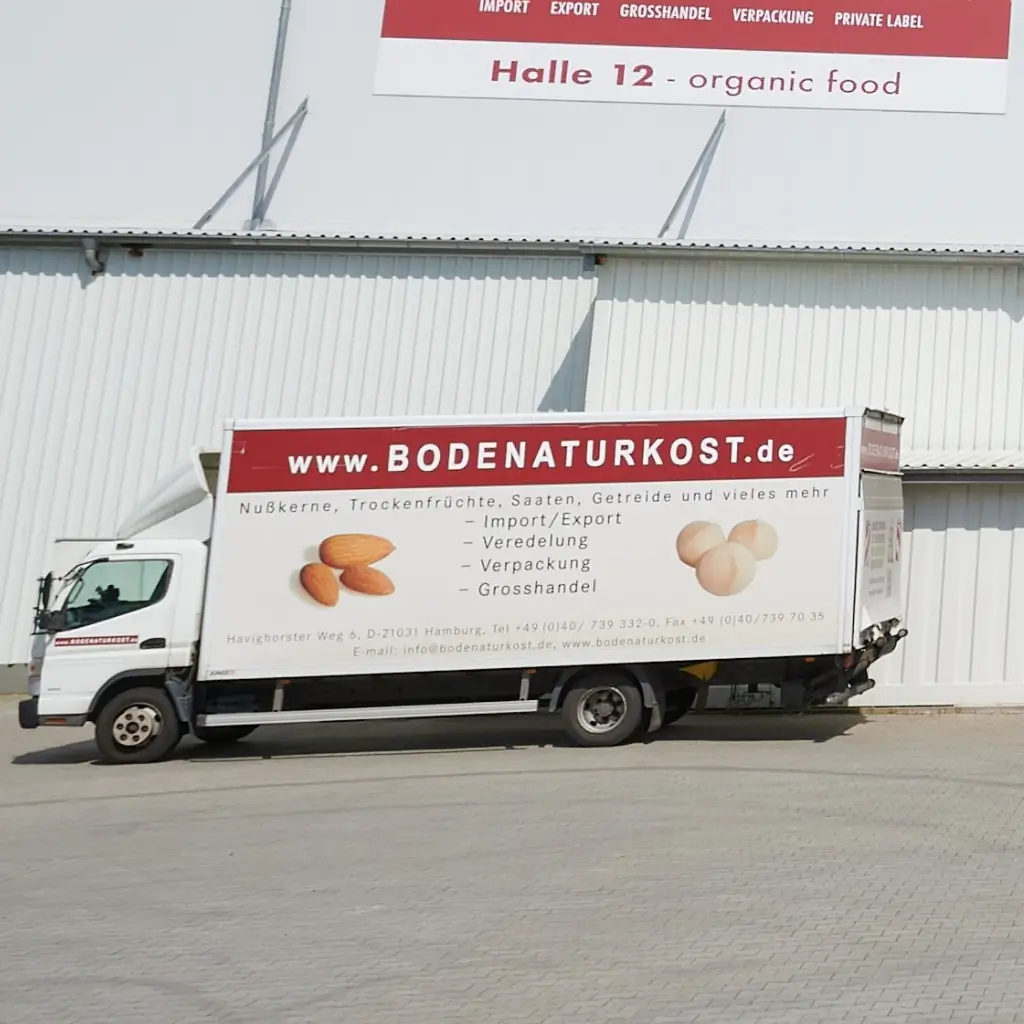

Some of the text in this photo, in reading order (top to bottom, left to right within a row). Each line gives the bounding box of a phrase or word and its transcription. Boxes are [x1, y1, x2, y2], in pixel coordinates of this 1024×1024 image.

[479, 0, 923, 28] IMPORT EXPORT GROSSHANDEL VERPACKUNG PRIVATE LABEL
[492, 60, 592, 84] Halle
[614, 64, 653, 86] 12
[689, 71, 813, 96] organic
[828, 69, 900, 94] food
[289, 437, 793, 473] www.BODENATURKOST.de
[240, 487, 828, 514] Nußkerne, Trockenfrüchte, Saaten, Getreide und vieles mehr
[485, 512, 621, 530] Import/Export
[483, 534, 587, 549] Veredelung
[481, 557, 590, 574] Verpackung
[479, 580, 596, 596] Grosshandel
[227, 633, 310, 645] Havighorster
[318, 632, 343, 642] Weg
[367, 628, 417, 638] D-21031
[493, 624, 509, 633] Tel
[591, 620, 613, 629] 739
[666, 618, 685, 626] Fax
[791, 612, 804, 621] 70
[811, 612, 824, 620] 35
[353, 646, 396, 656] E-mail:
[563, 635, 705, 648] www.bodenaturkost.de
